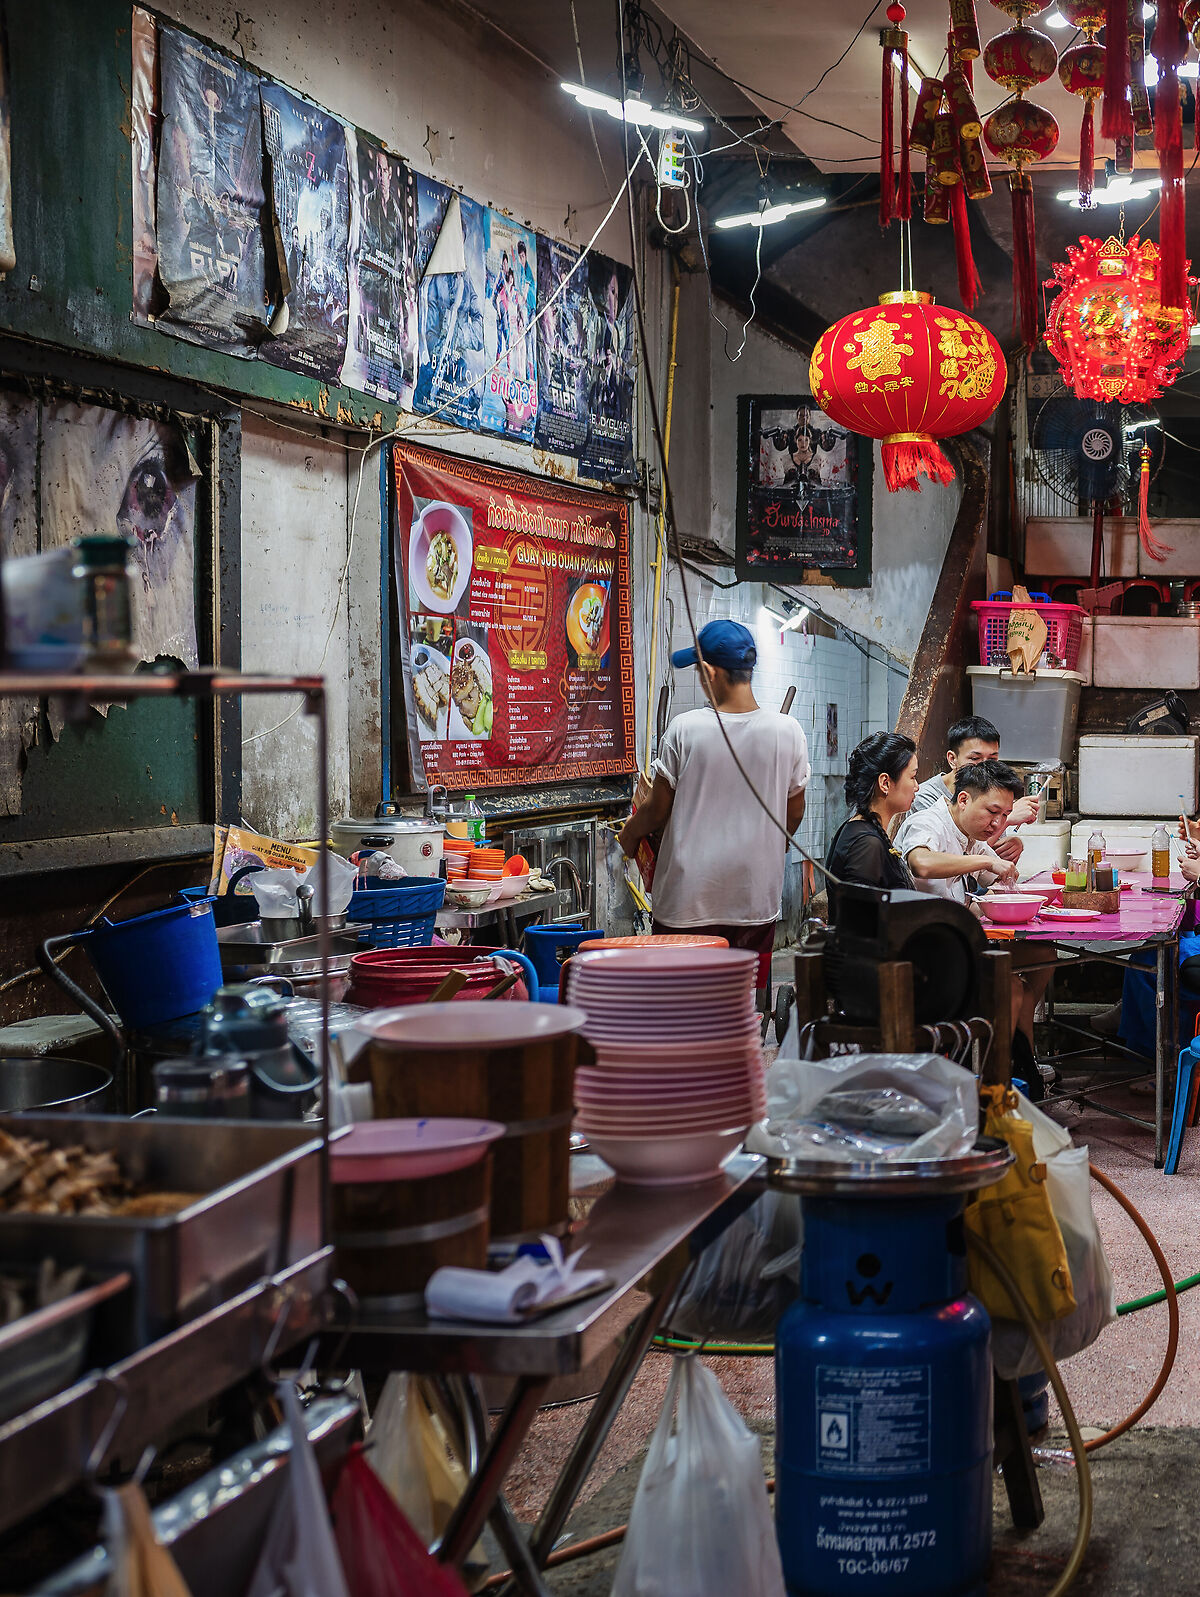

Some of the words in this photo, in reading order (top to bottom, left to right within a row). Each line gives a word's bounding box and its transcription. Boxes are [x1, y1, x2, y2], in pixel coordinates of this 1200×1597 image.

[517, 547, 540, 565] GUAY
[541, 550, 557, 568] JUB
[558, 553, 580, 572] OUAN
[270, 843, 291, 854] MENU
